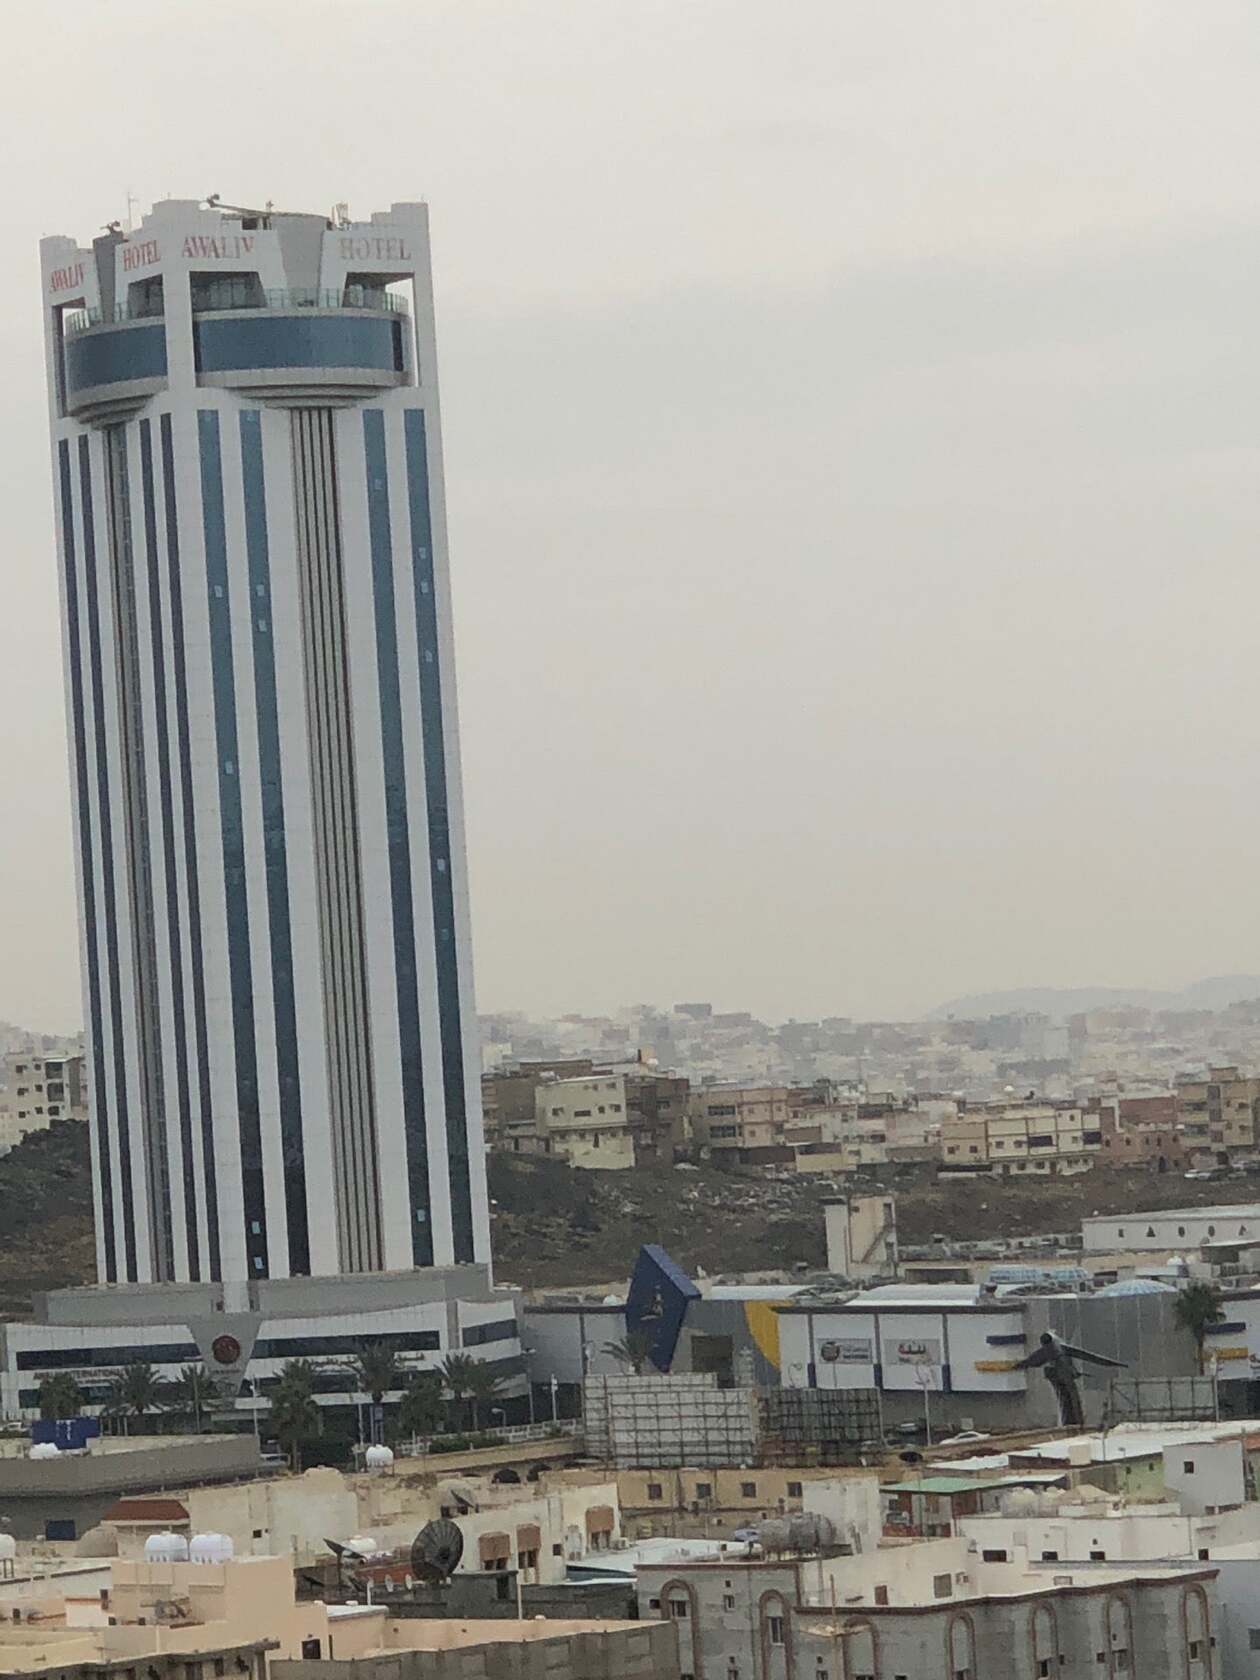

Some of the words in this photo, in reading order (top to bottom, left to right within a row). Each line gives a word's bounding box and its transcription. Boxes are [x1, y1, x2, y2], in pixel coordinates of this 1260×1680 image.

[122, 240, 162, 272] HOTEL
[181, 236, 254, 259] AWALIV
[338, 236, 412, 260] HOTEL
